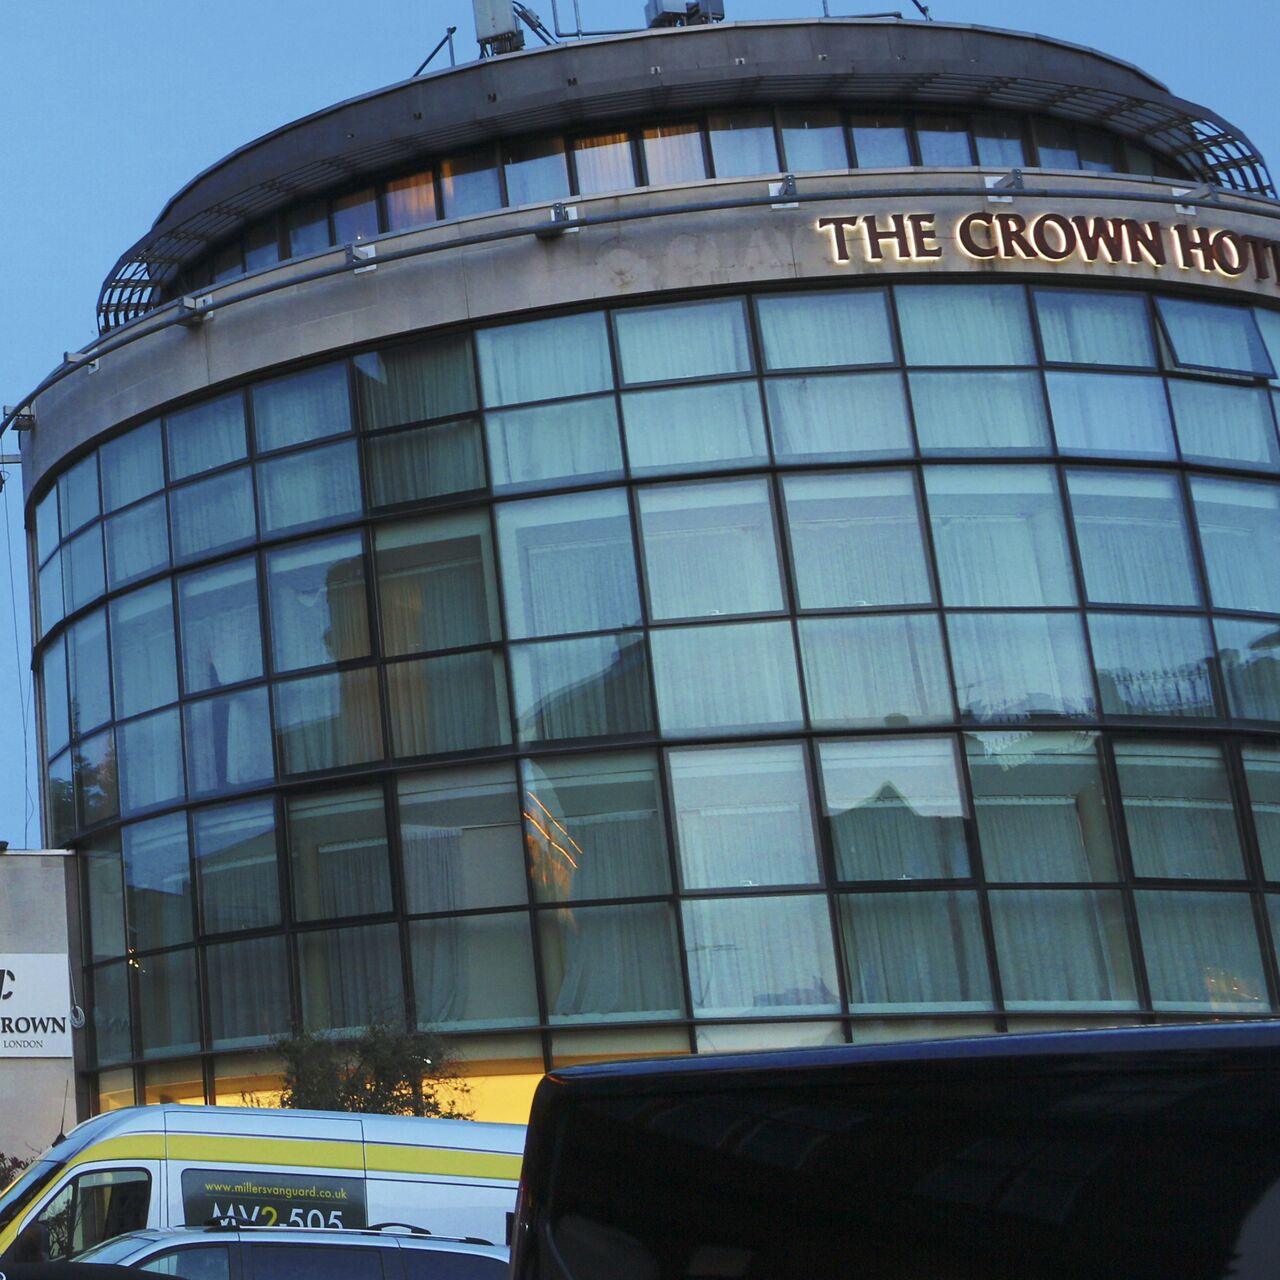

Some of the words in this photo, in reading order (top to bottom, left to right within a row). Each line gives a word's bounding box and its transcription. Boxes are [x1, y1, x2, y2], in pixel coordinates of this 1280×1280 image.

[819, 213, 942, 262] THE
[958, 212, 1166, 267] CROWN
[4, 1040, 43, 1048] LONDON
[205, 1182, 348, 1199] www.millersvanguard.co.uk
